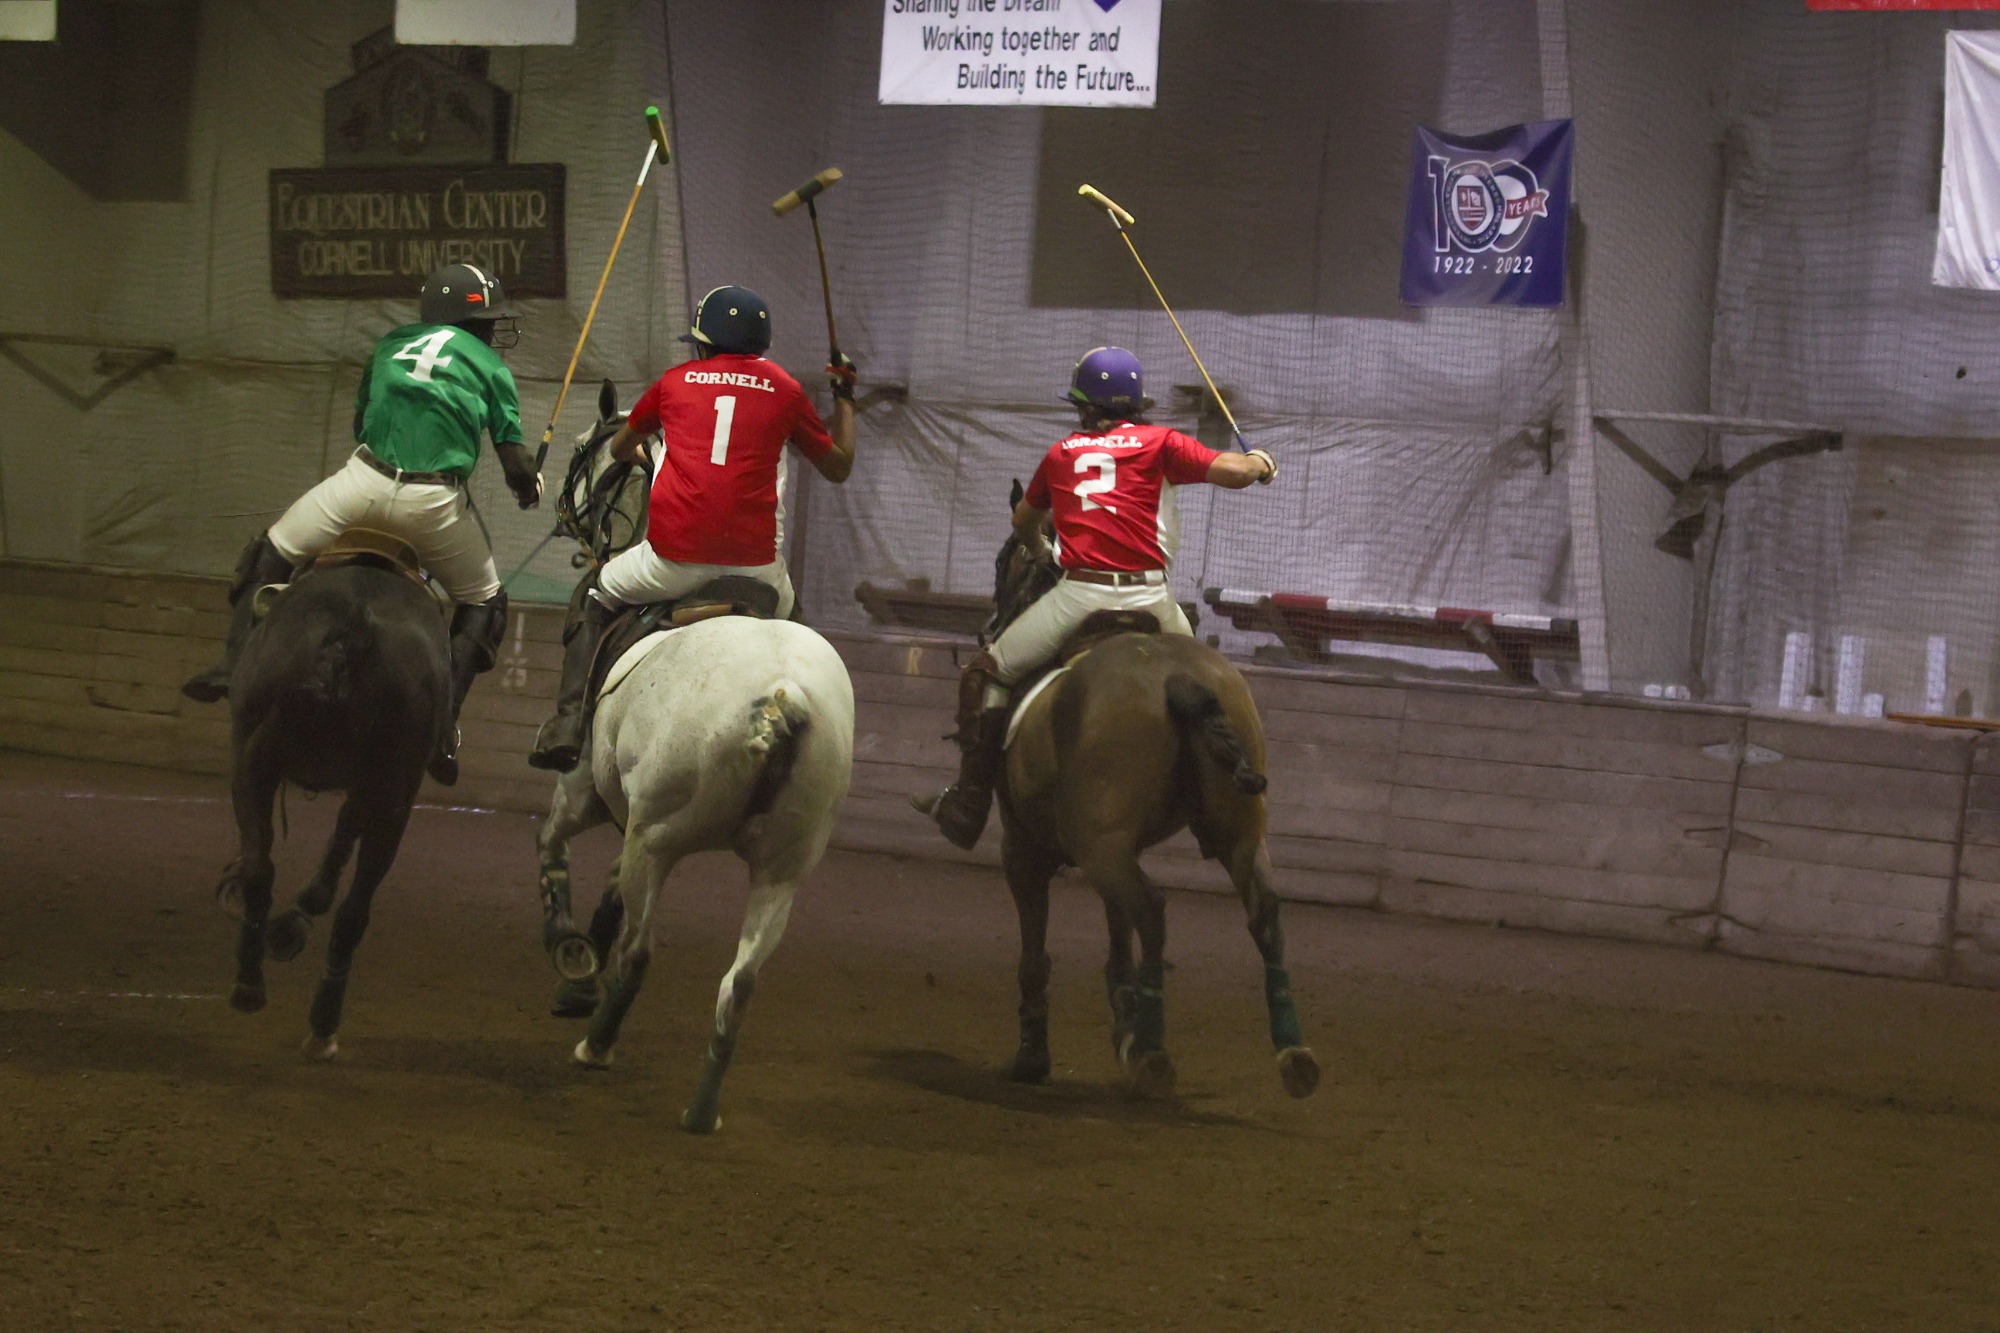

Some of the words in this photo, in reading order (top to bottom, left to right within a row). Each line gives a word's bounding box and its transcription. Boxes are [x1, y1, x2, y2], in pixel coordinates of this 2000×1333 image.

[922, 25, 993, 56] Working
[1001, 26, 1080, 56] together
[1088, 26, 1121, 51] and
[957, 63, 1026, 95] Building
[1035, 64, 1067, 90] the
[298, 240, 394, 276] CORNELL
[400, 239, 526, 275] UNIVERSITY
[1434, 256, 1475, 274] 1922
[1495, 255, 1534, 274] 2022
[392, 329, 456, 382] 4
[684, 370, 775, 393] CORNELL
[710, 395, 736, 466] 1
[1073, 452, 1117, 515] 2
